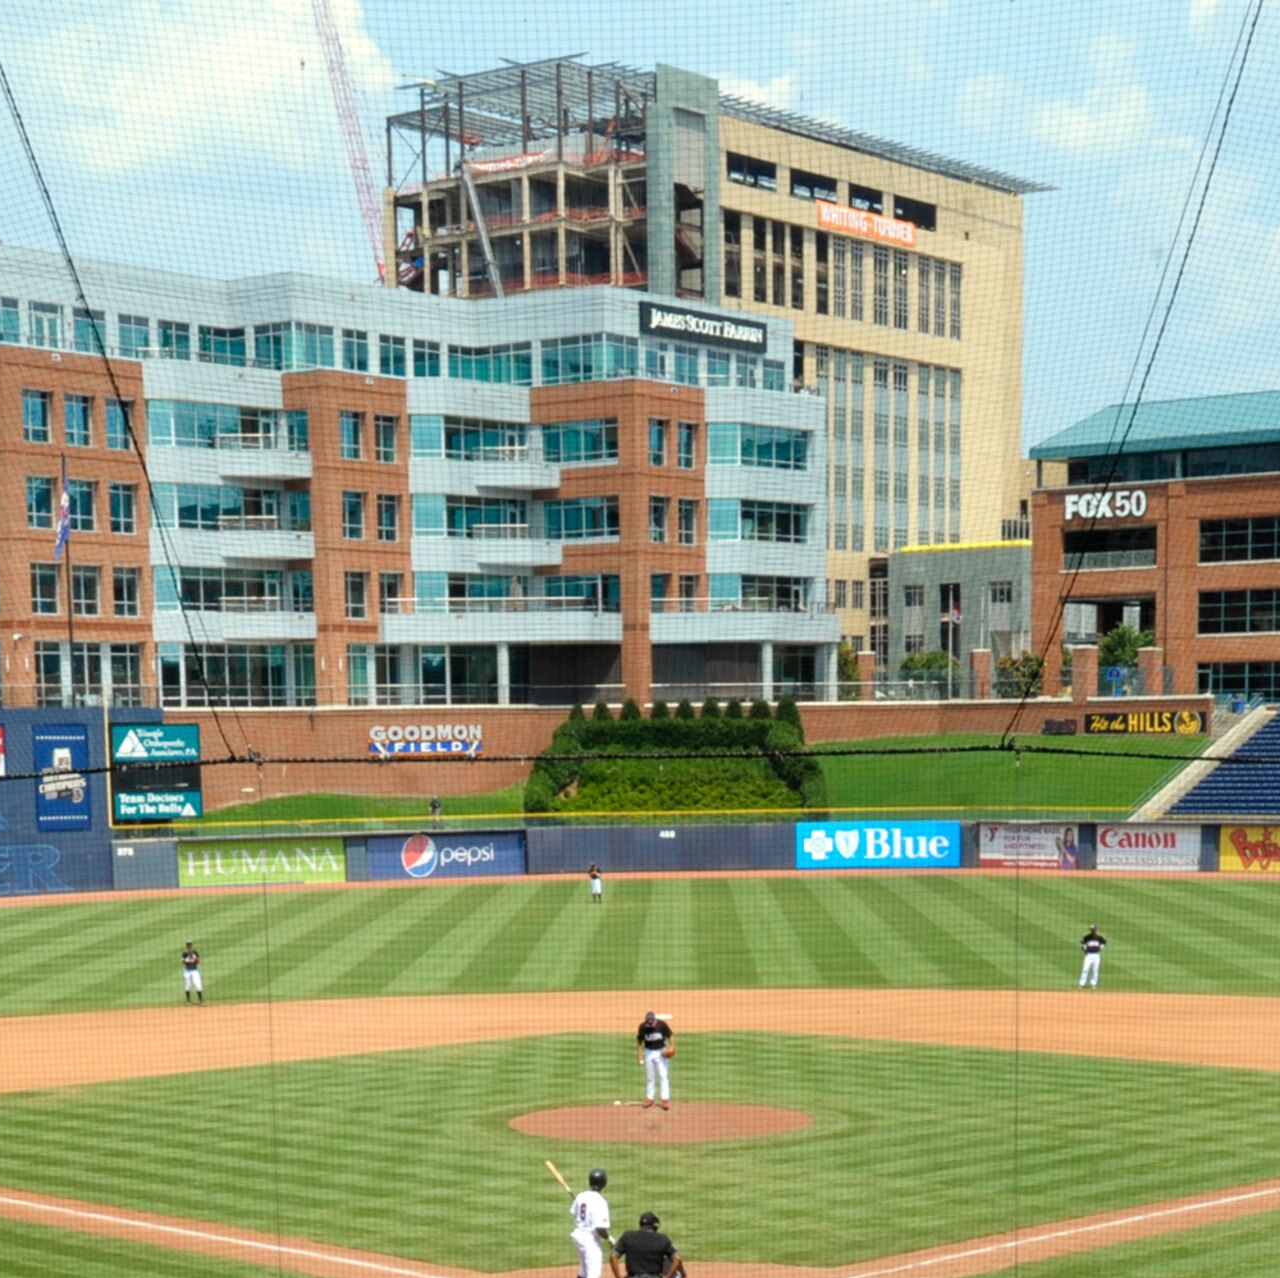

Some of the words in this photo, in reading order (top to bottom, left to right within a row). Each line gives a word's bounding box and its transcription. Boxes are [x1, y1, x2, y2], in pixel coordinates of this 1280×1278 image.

[821, 202, 914, 243] WHITING-TURNER
[650, 308, 686, 330] JAMES
[685, 314, 723, 336] SCOTT
[1064, 492, 1113, 520] FOX
[1115, 489, 1147, 518] 50
[369, 725, 482, 741] GOODMON
[1127, 711, 1172, 733] HILLS
[394, 741, 464, 753] FIELD
[119, 793, 146, 804] Team
[147, 791, 185, 803] Doctors
[120, 804, 137, 815] For
[138, 803, 157, 814] The
[158, 802, 182, 813] Bulls
[864, 827, 950, 860] Blue
[1100, 827, 1177, 849] Canon
[186, 847, 342, 877] HUMANA
[440, 843, 495, 866] pepsi
